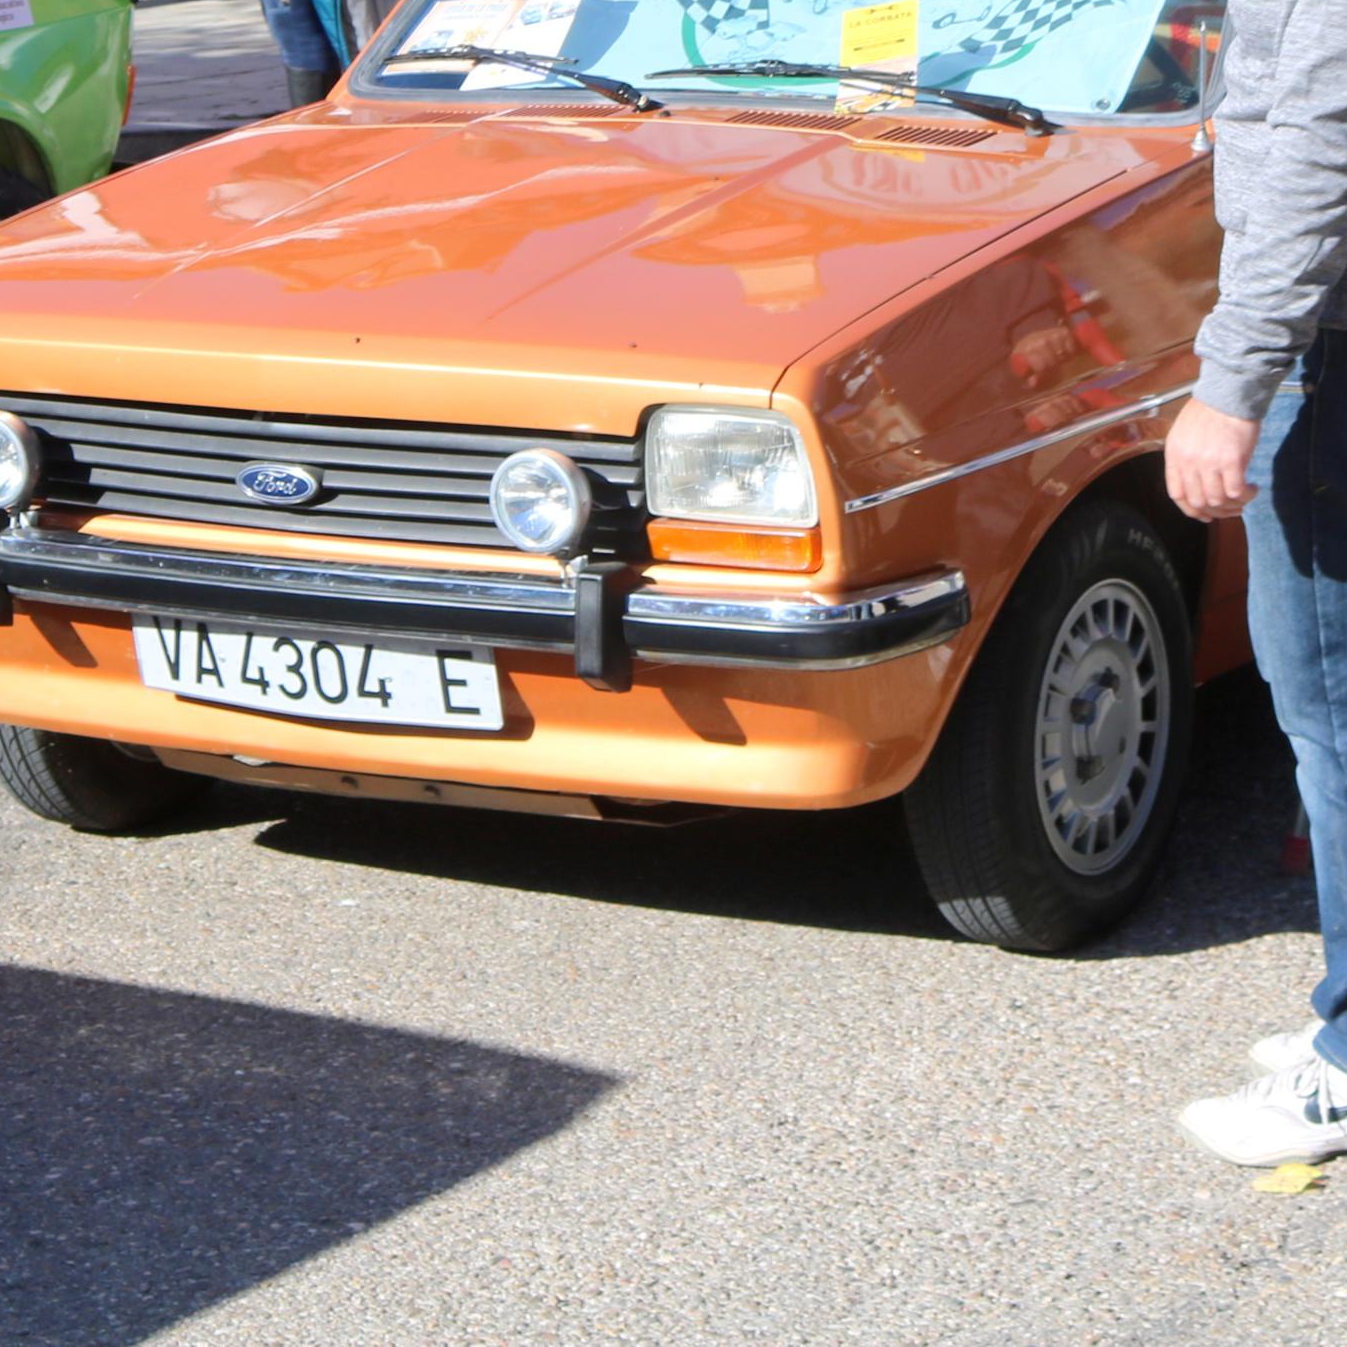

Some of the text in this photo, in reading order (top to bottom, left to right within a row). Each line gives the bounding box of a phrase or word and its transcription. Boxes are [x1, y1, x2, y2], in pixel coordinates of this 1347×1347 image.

[251, 465, 300, 498] Ford
[154, 614, 482, 717] VA 4304 E
